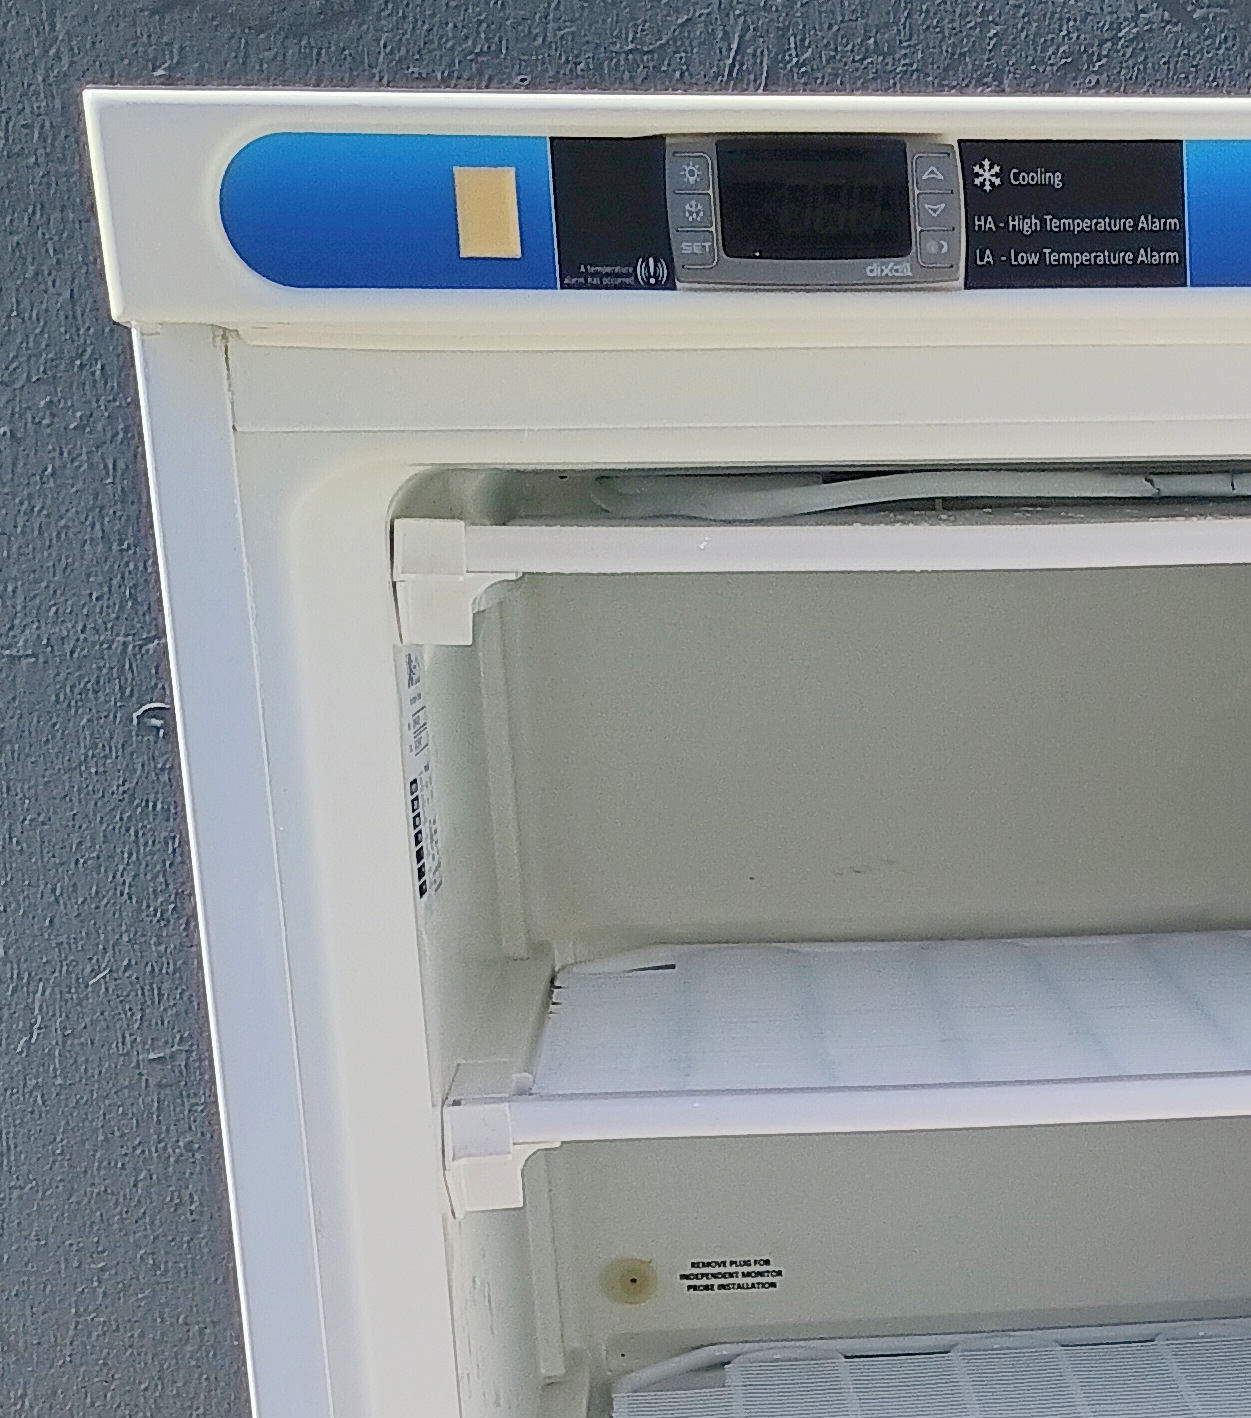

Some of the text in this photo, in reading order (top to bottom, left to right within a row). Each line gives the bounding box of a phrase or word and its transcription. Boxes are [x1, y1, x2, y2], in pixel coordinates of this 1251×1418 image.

[1009, 168, 1063, 189] Cooling
[974, 215, 996, 231] HA
[1008, 215, 1040, 235] High
[1044, 214, 1133, 234] Temperature
[1138, 214, 1180, 231] Alarm
[681, 242, 712, 254] SET
[976, 249, 994, 265] LA
[1011, 249, 1039, 265] Low
[1043, 249, 1133, 268] Temperature
[1137, 248, 1179, 265] Alarm
[691, 1258, 771, 1269] REMOVE PLUG FOR
[679, 1269, 783, 1280] INDEPENDENT MONITOR
[687, 1281, 777, 1292] PROBE INSTALLATION
